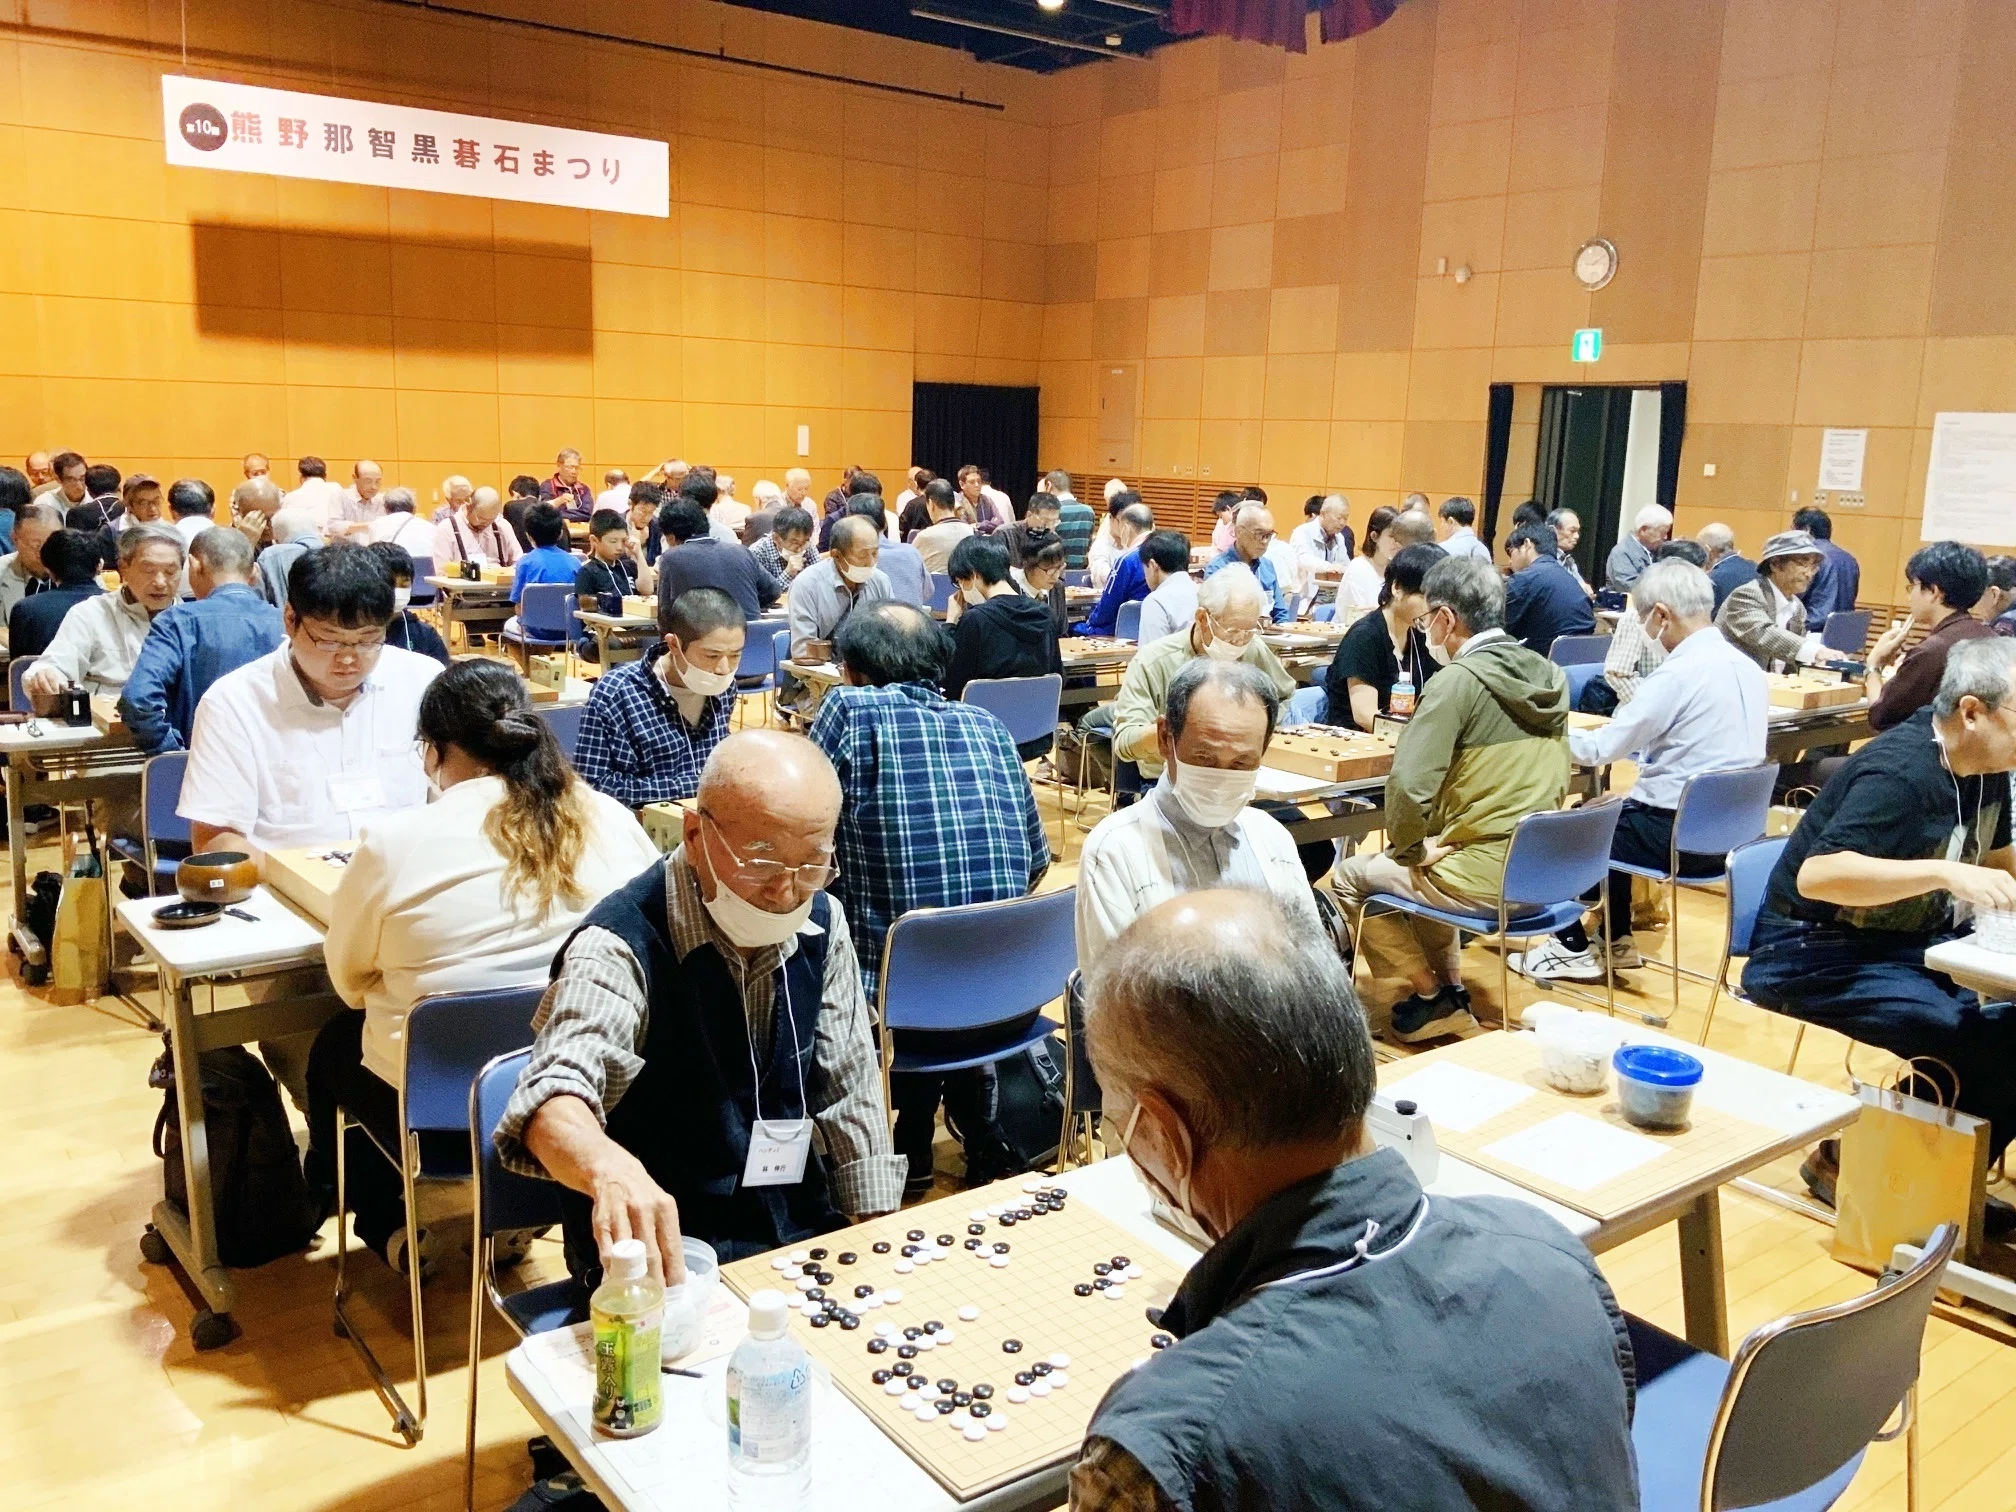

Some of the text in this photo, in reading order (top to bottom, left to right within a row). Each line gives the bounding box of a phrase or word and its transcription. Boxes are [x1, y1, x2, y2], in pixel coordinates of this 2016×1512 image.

[230, 110, 620, 185] 熊野那智黒碁石まつり
